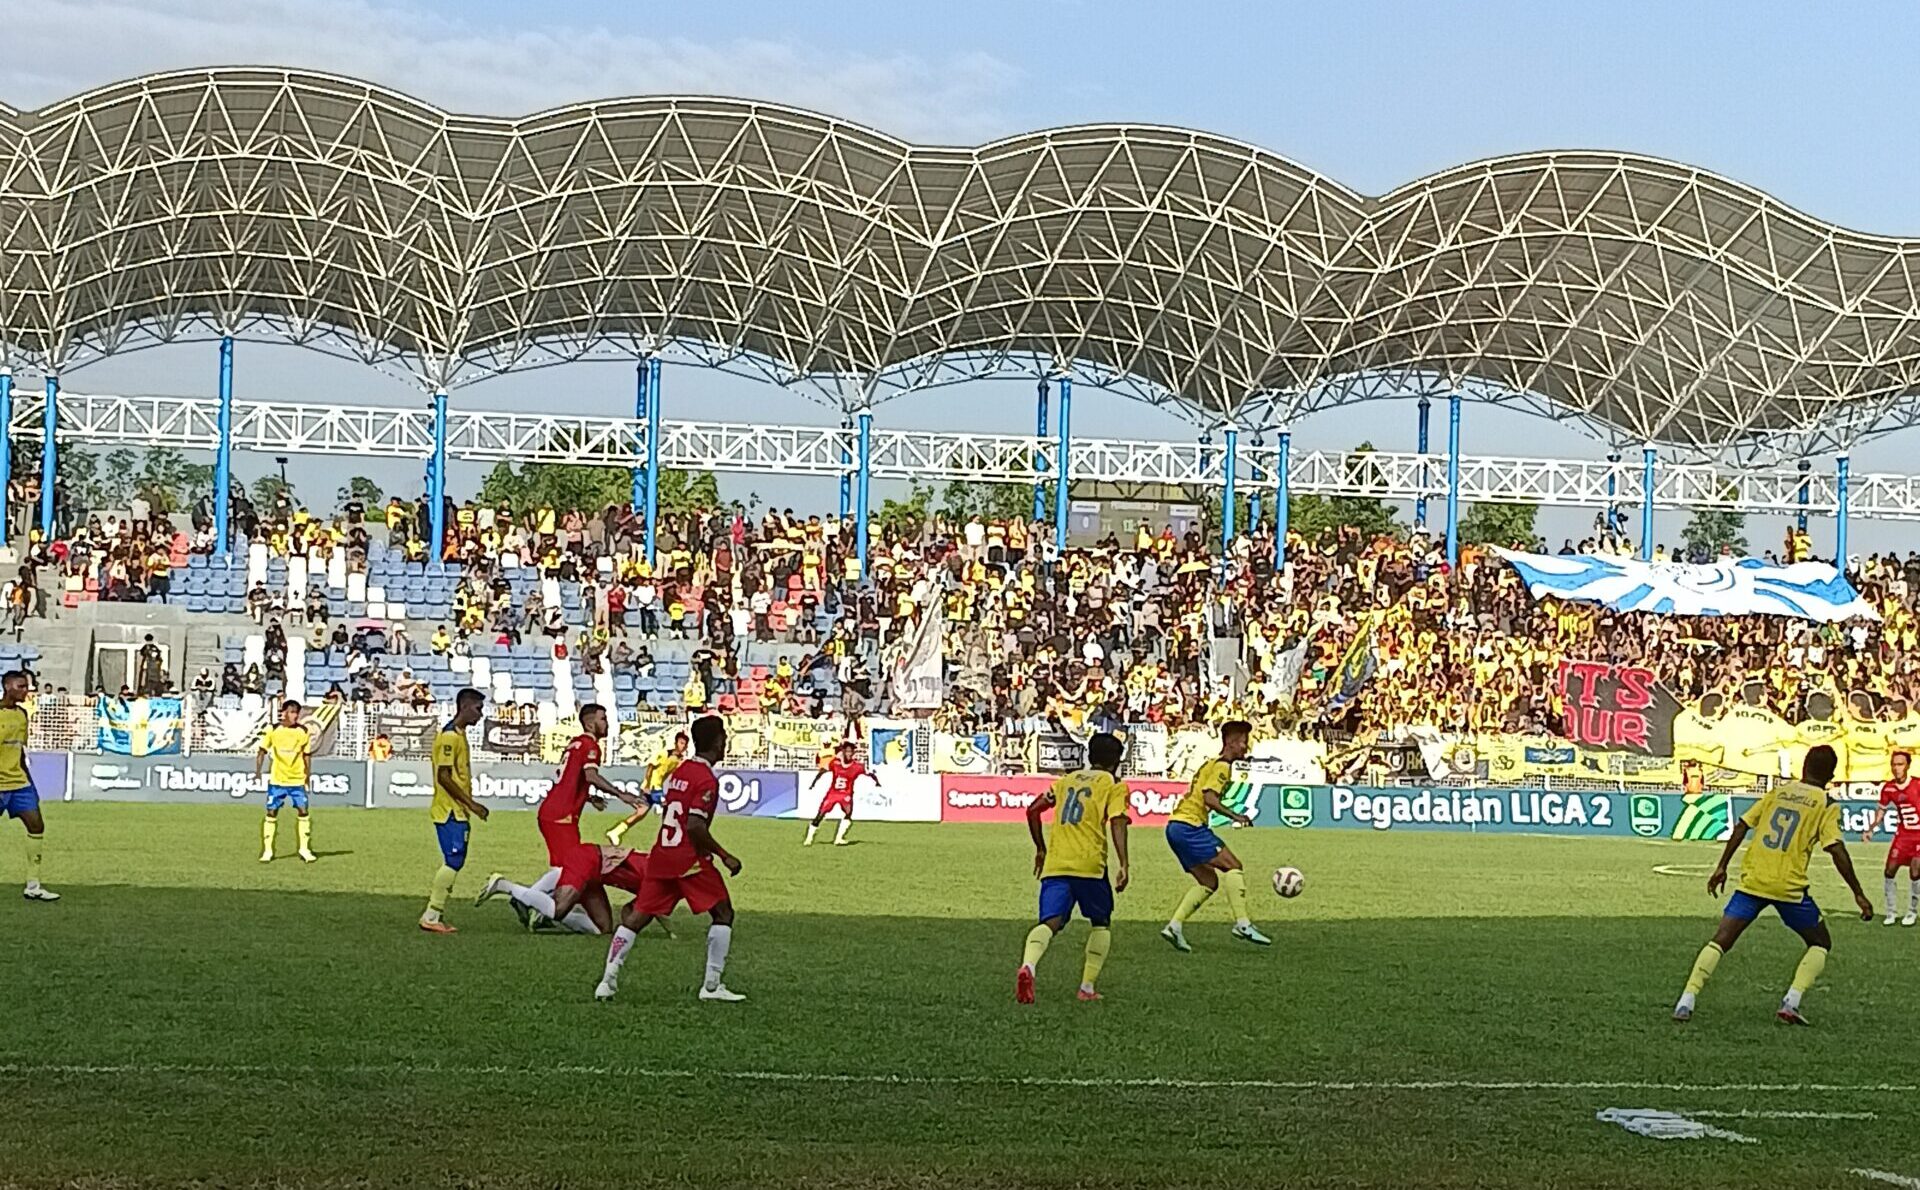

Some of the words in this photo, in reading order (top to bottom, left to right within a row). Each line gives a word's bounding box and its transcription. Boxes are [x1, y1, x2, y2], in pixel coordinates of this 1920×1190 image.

[948, 789, 997, 808] Sports
[1061, 786, 1092, 825] 16
[1331, 786, 1503, 829] Pegadaian
[1511, 791, 1587, 825] LIGA
[1590, 795, 1612, 826] 2
[1762, 806, 1801, 852] 57
